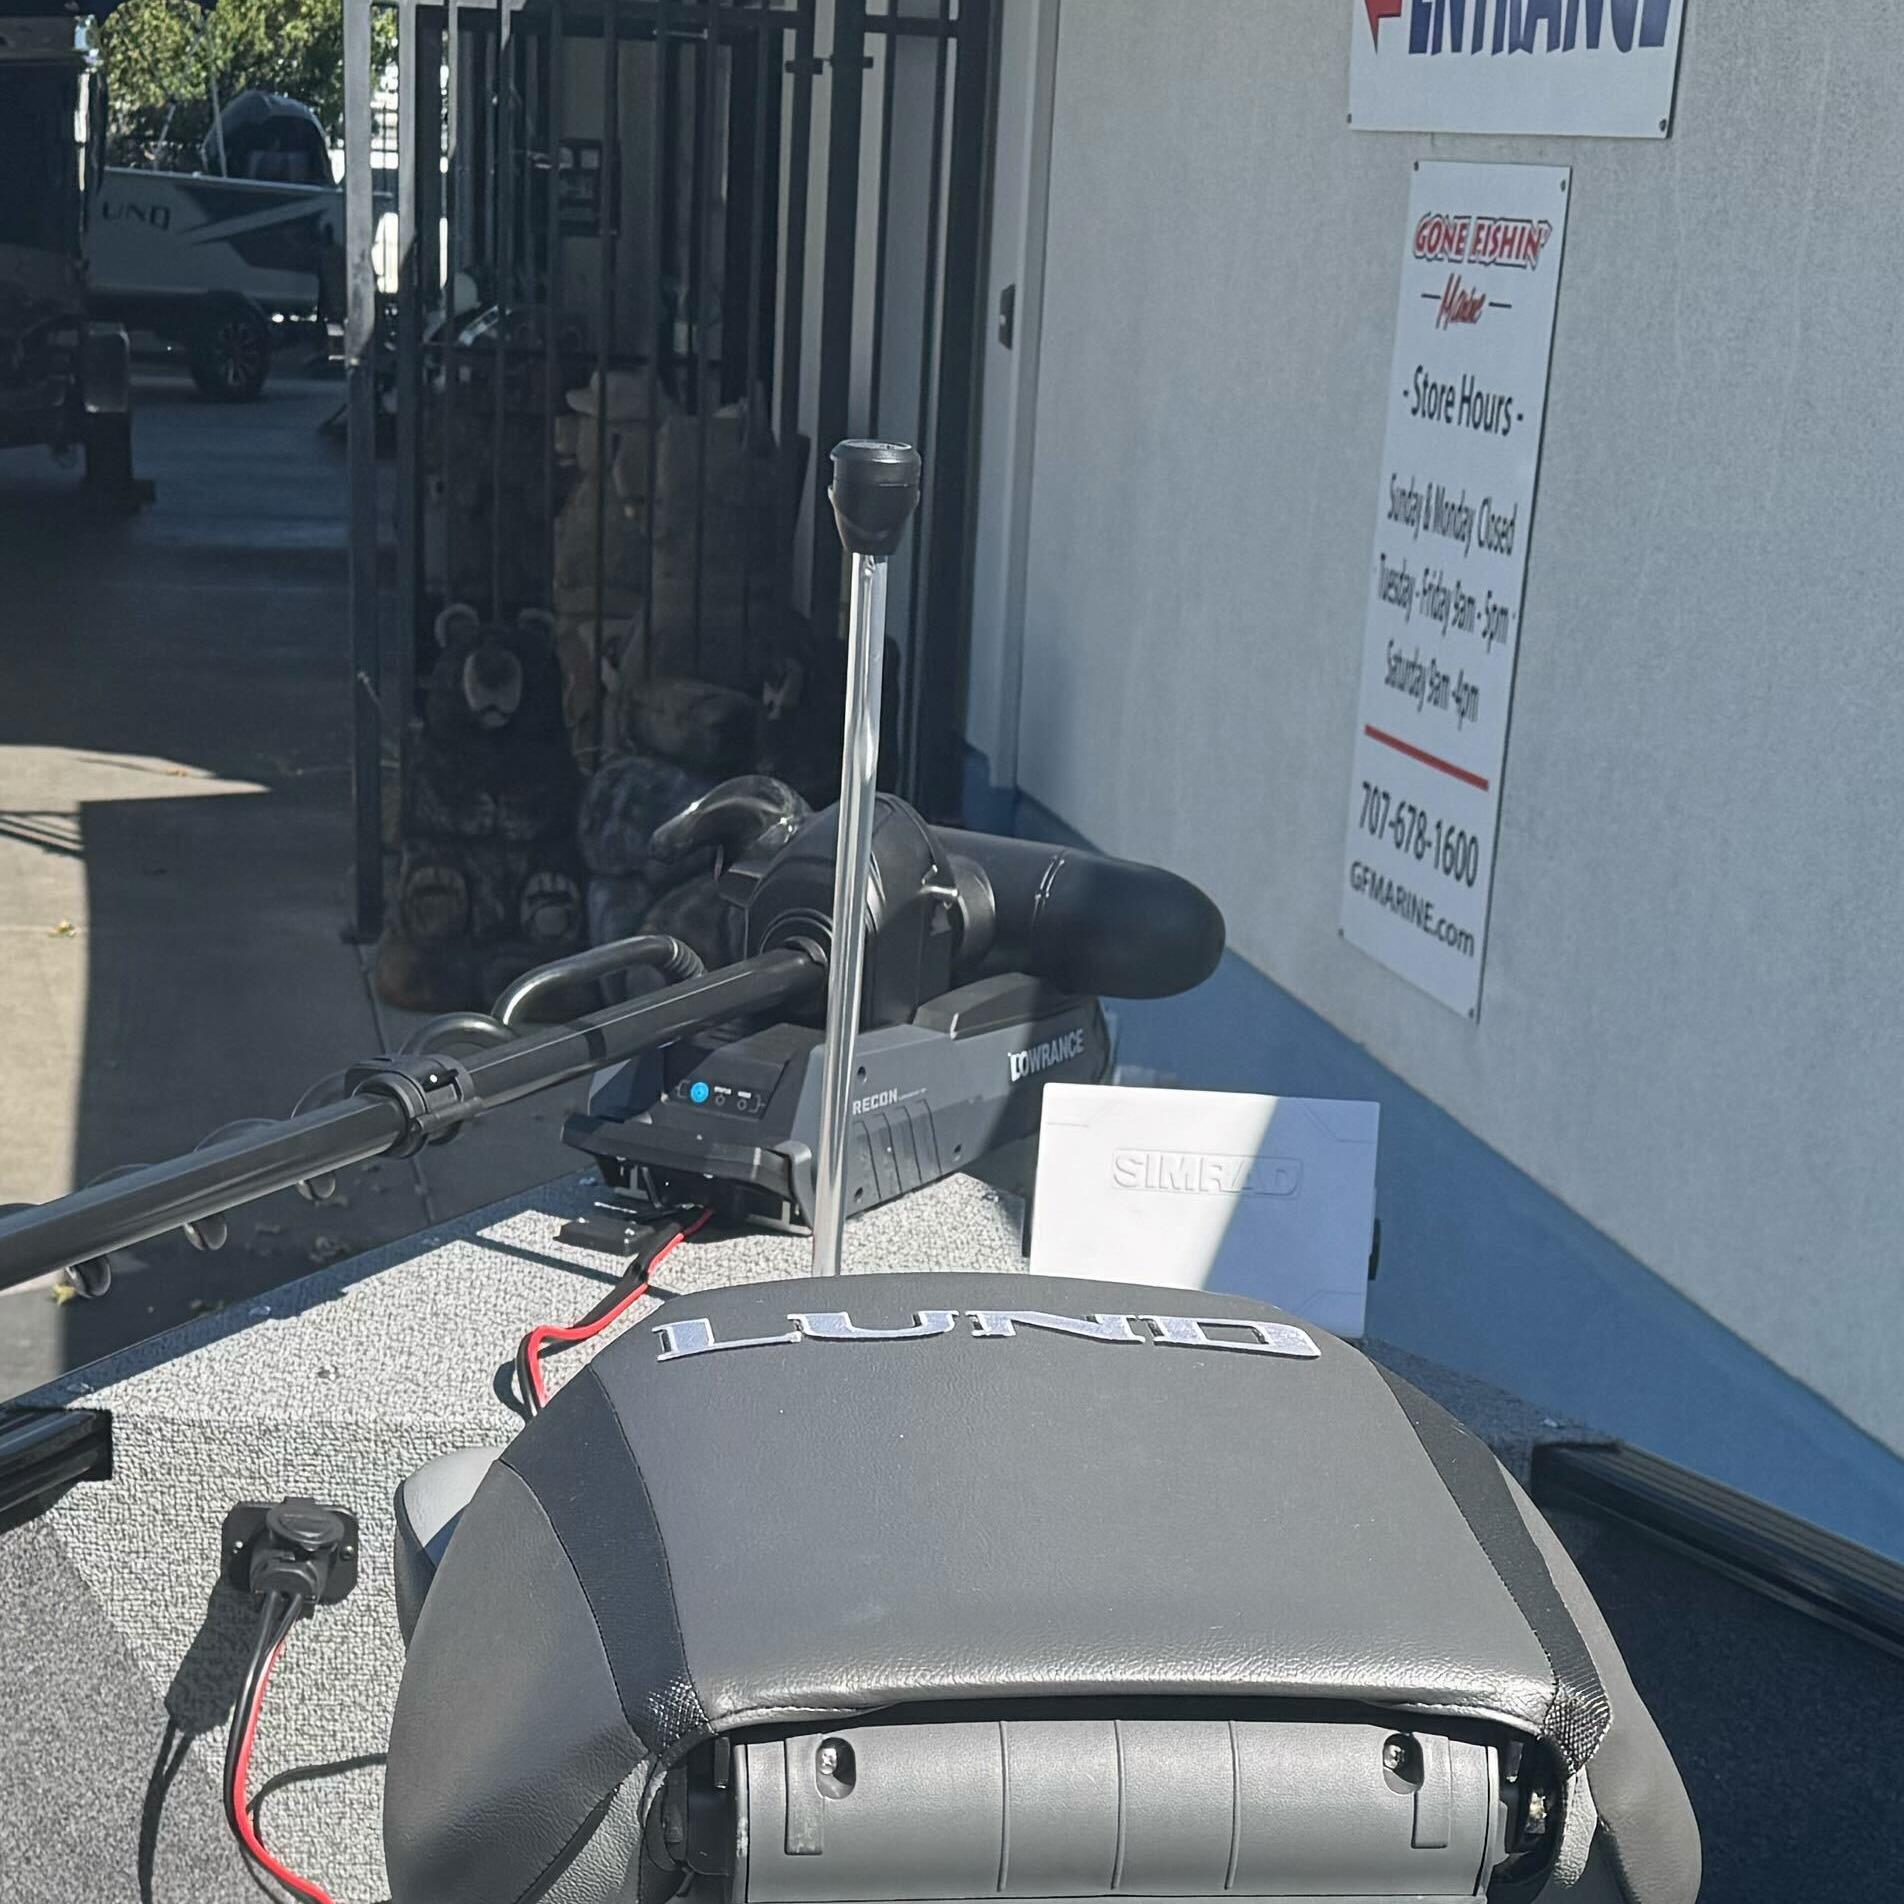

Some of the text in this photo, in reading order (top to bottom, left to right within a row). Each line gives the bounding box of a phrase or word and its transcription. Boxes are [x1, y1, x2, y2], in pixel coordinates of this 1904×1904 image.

[102, 202, 170, 230] UND
[1414, 214, 1470, 262] GONE
[1411, 365, 1456, 424] Store
[1457, 373, 1513, 437] Hours
[1387, 473, 1423, 543] Sunday
[1433, 484, 1476, 558] Monday
[1477, 496, 1518, 556] Closed
[1378, 553, 1416, 624] Tuesday
[1419, 567, 1451, 637] Friday
[1482, 590, 1509, 654] 5pm
[1384, 639, 1427, 713] Saturday
[1359, 780, 1480, 888] 707-678-1600
[1349, 860, 1475, 958] GFMARINE.com
[1007, 1028, 1084, 1082] LOWRANCE
[852, 1088, 897, 1115] RECON
[1113, 1150, 1298, 1196] SIMRAD
[651, 1308, 1321, 1361] LUND
